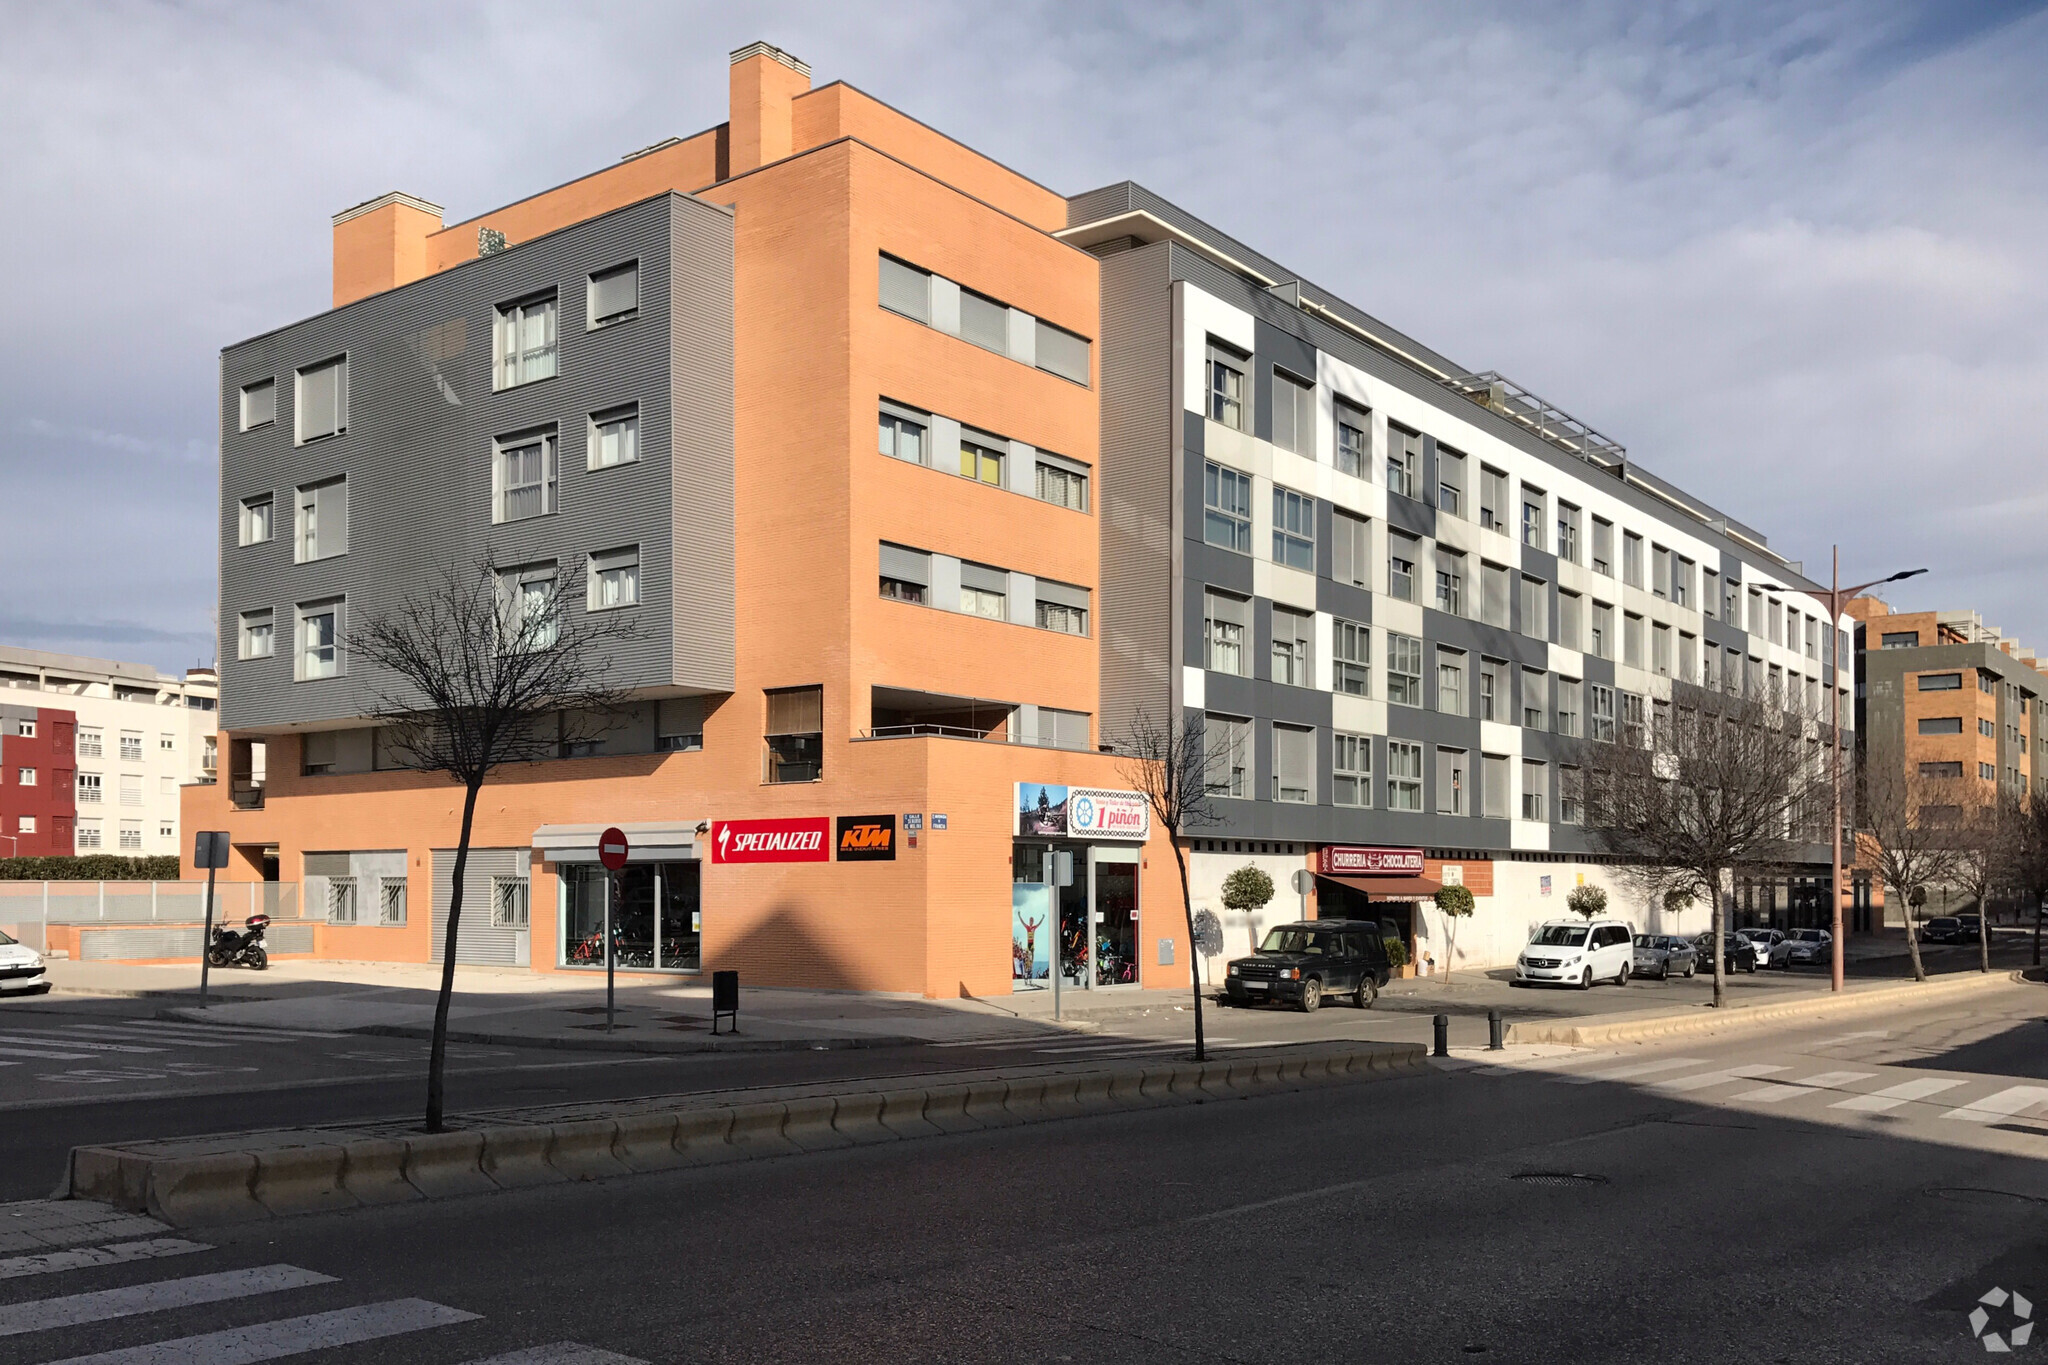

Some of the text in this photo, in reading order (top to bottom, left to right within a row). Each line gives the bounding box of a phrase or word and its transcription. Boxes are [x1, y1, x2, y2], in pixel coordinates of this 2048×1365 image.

[1096, 806, 1140, 829] 1 piñón
[732, 831, 822, 852] SPECIALIZED
[840, 824, 892, 848] KTM
[1382, 854, 1422, 869] CHOCOLATERIA
